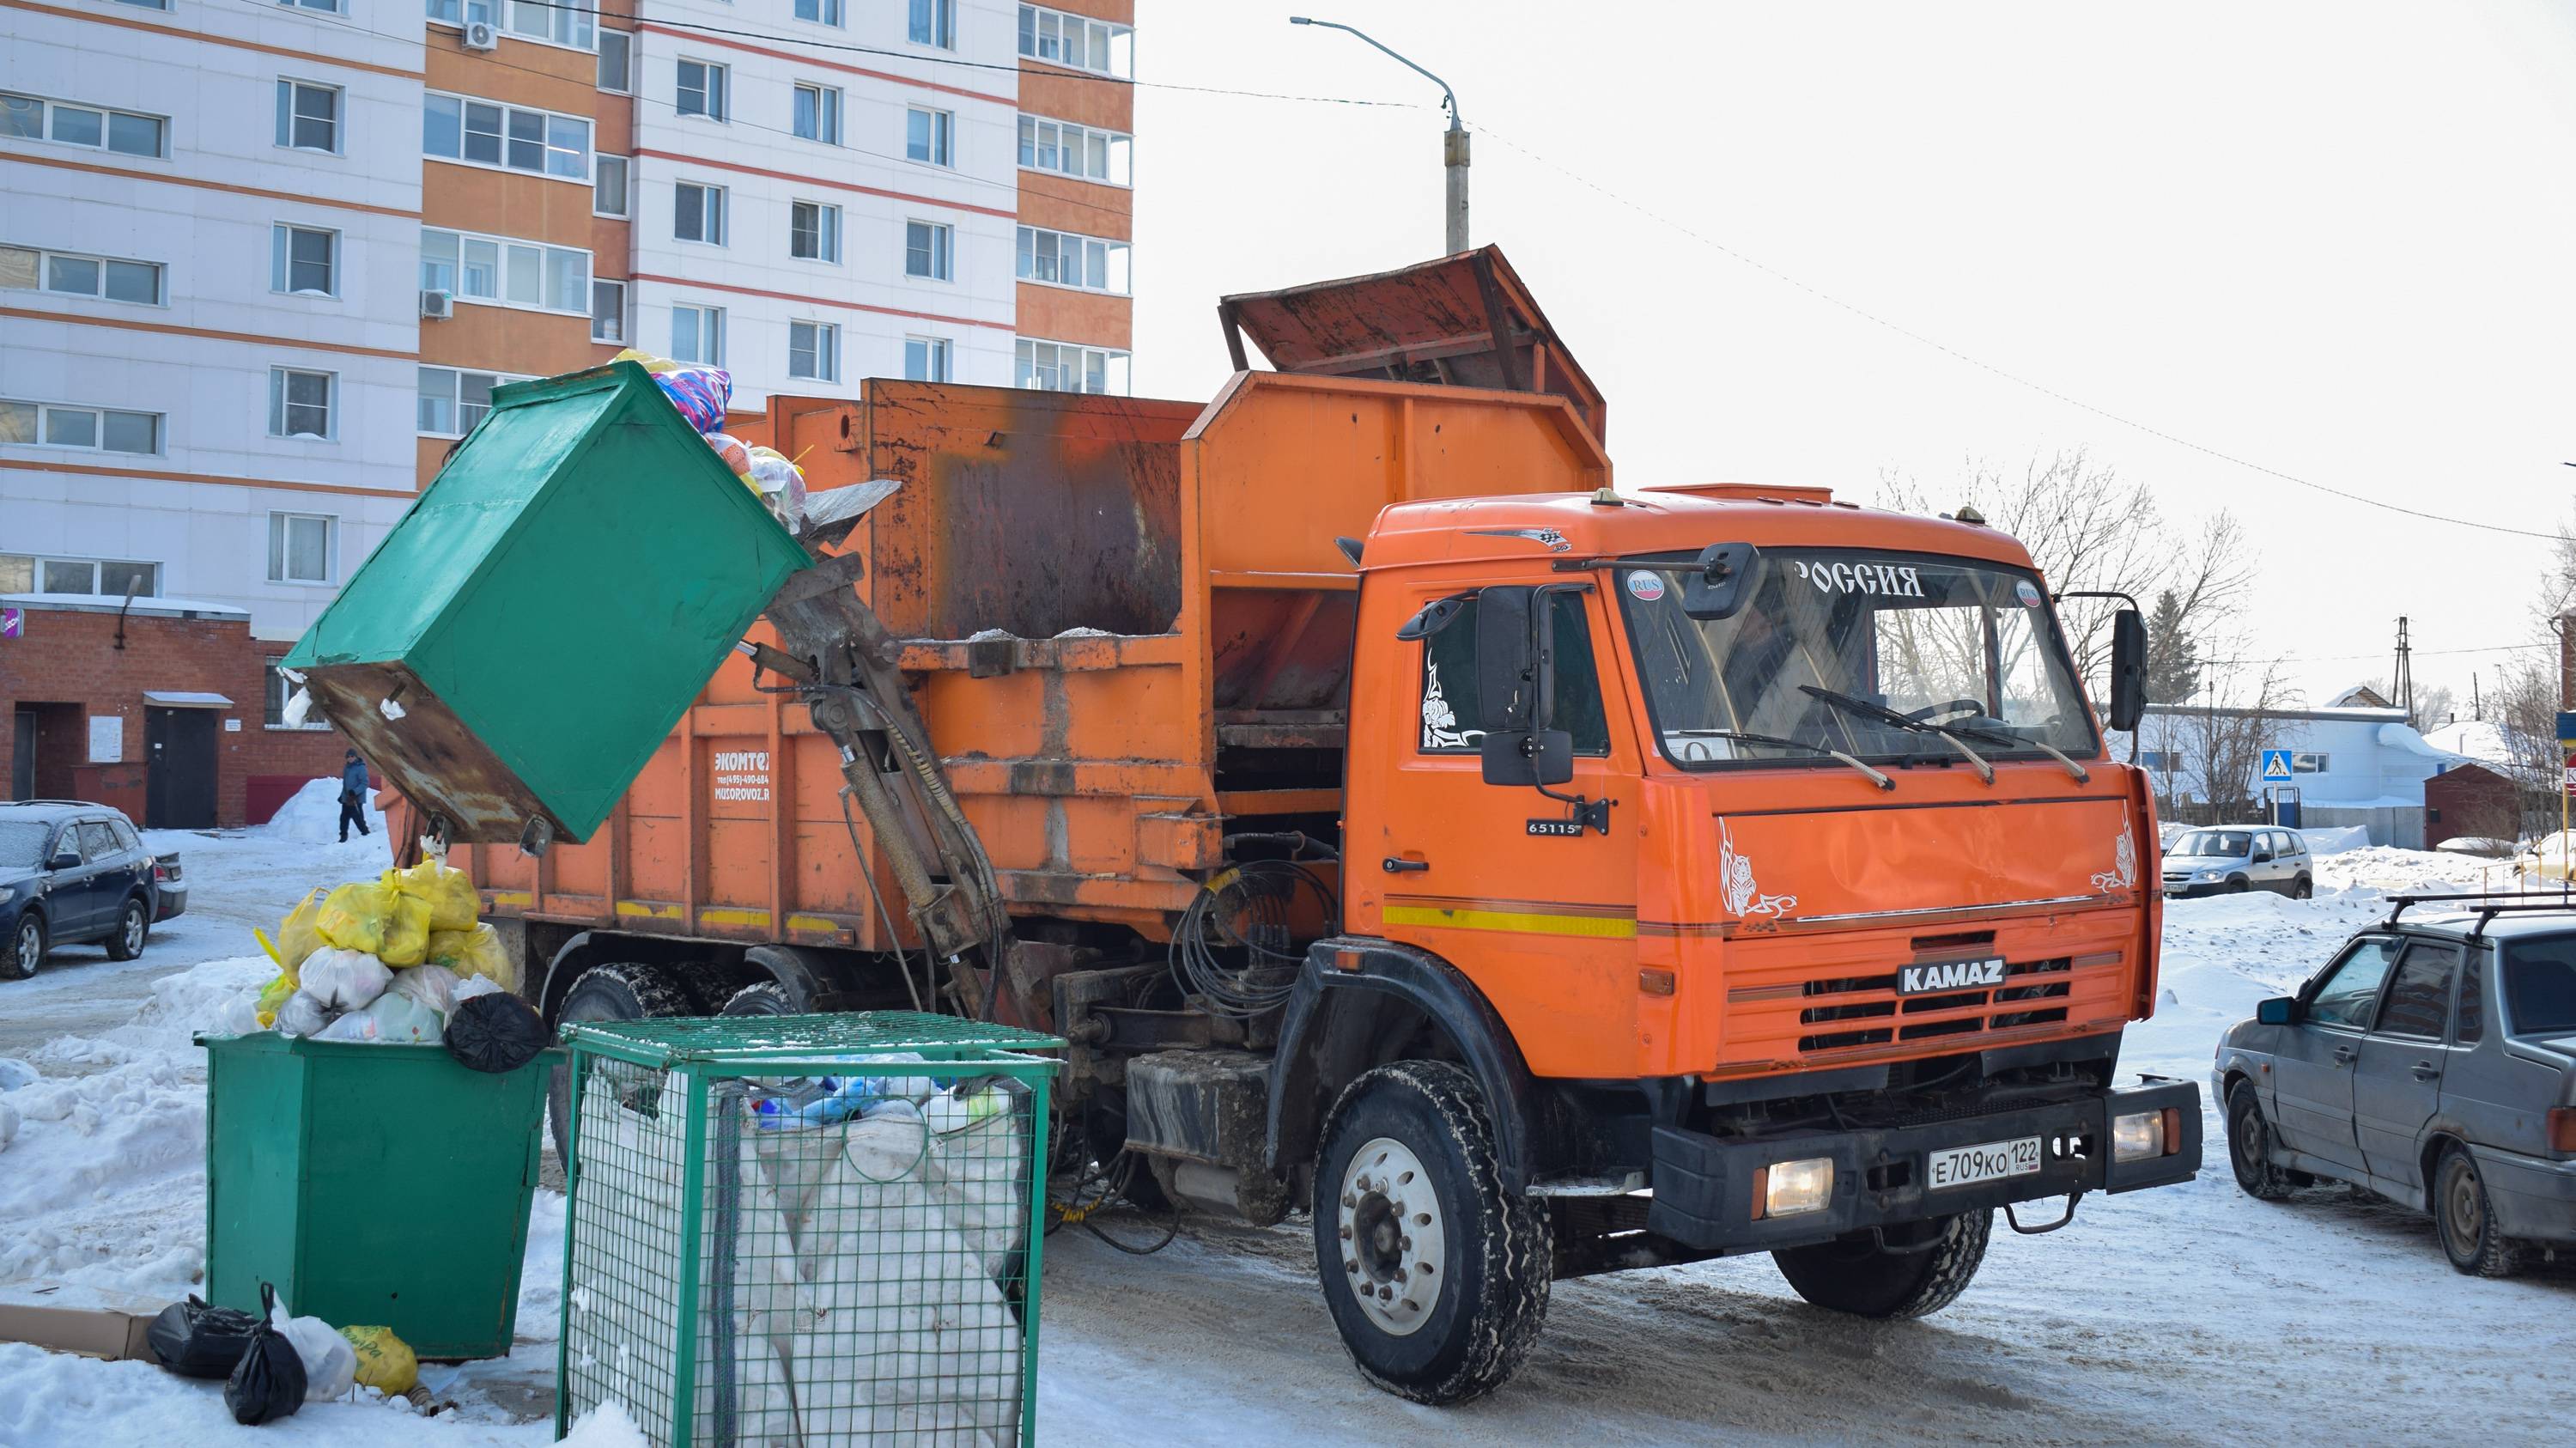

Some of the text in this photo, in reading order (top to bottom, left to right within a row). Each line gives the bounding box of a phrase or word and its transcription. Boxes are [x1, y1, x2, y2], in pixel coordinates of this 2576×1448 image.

[1632, 579, 1661, 592] RUS
[1529, 824, 1575, 834] 65115
[1904, 959, 2003, 992] KAMAZ
[2011, 1141, 2036, 1163] 122
